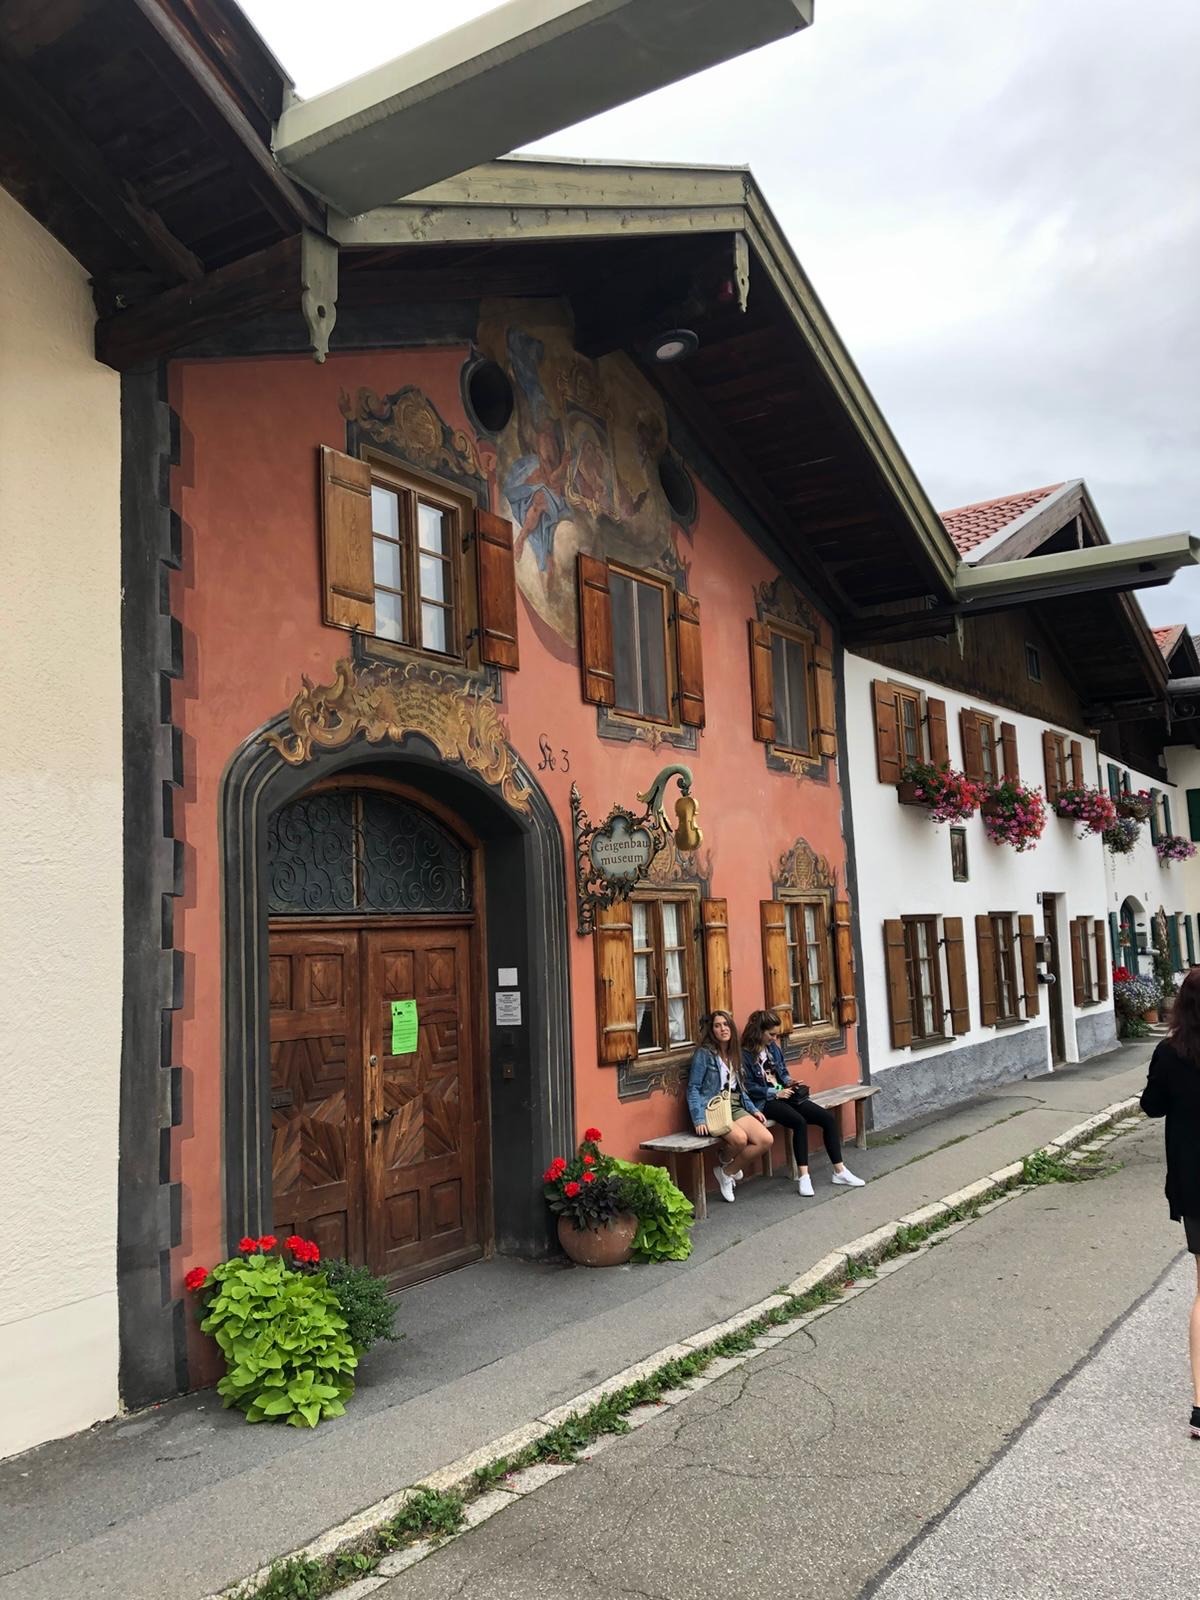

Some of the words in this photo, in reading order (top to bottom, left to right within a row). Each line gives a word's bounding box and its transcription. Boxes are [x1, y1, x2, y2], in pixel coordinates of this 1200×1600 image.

[560, 749, 570, 773] 3
[594, 836, 649, 854] Geigenbau
[600, 854, 644, 866] museum
